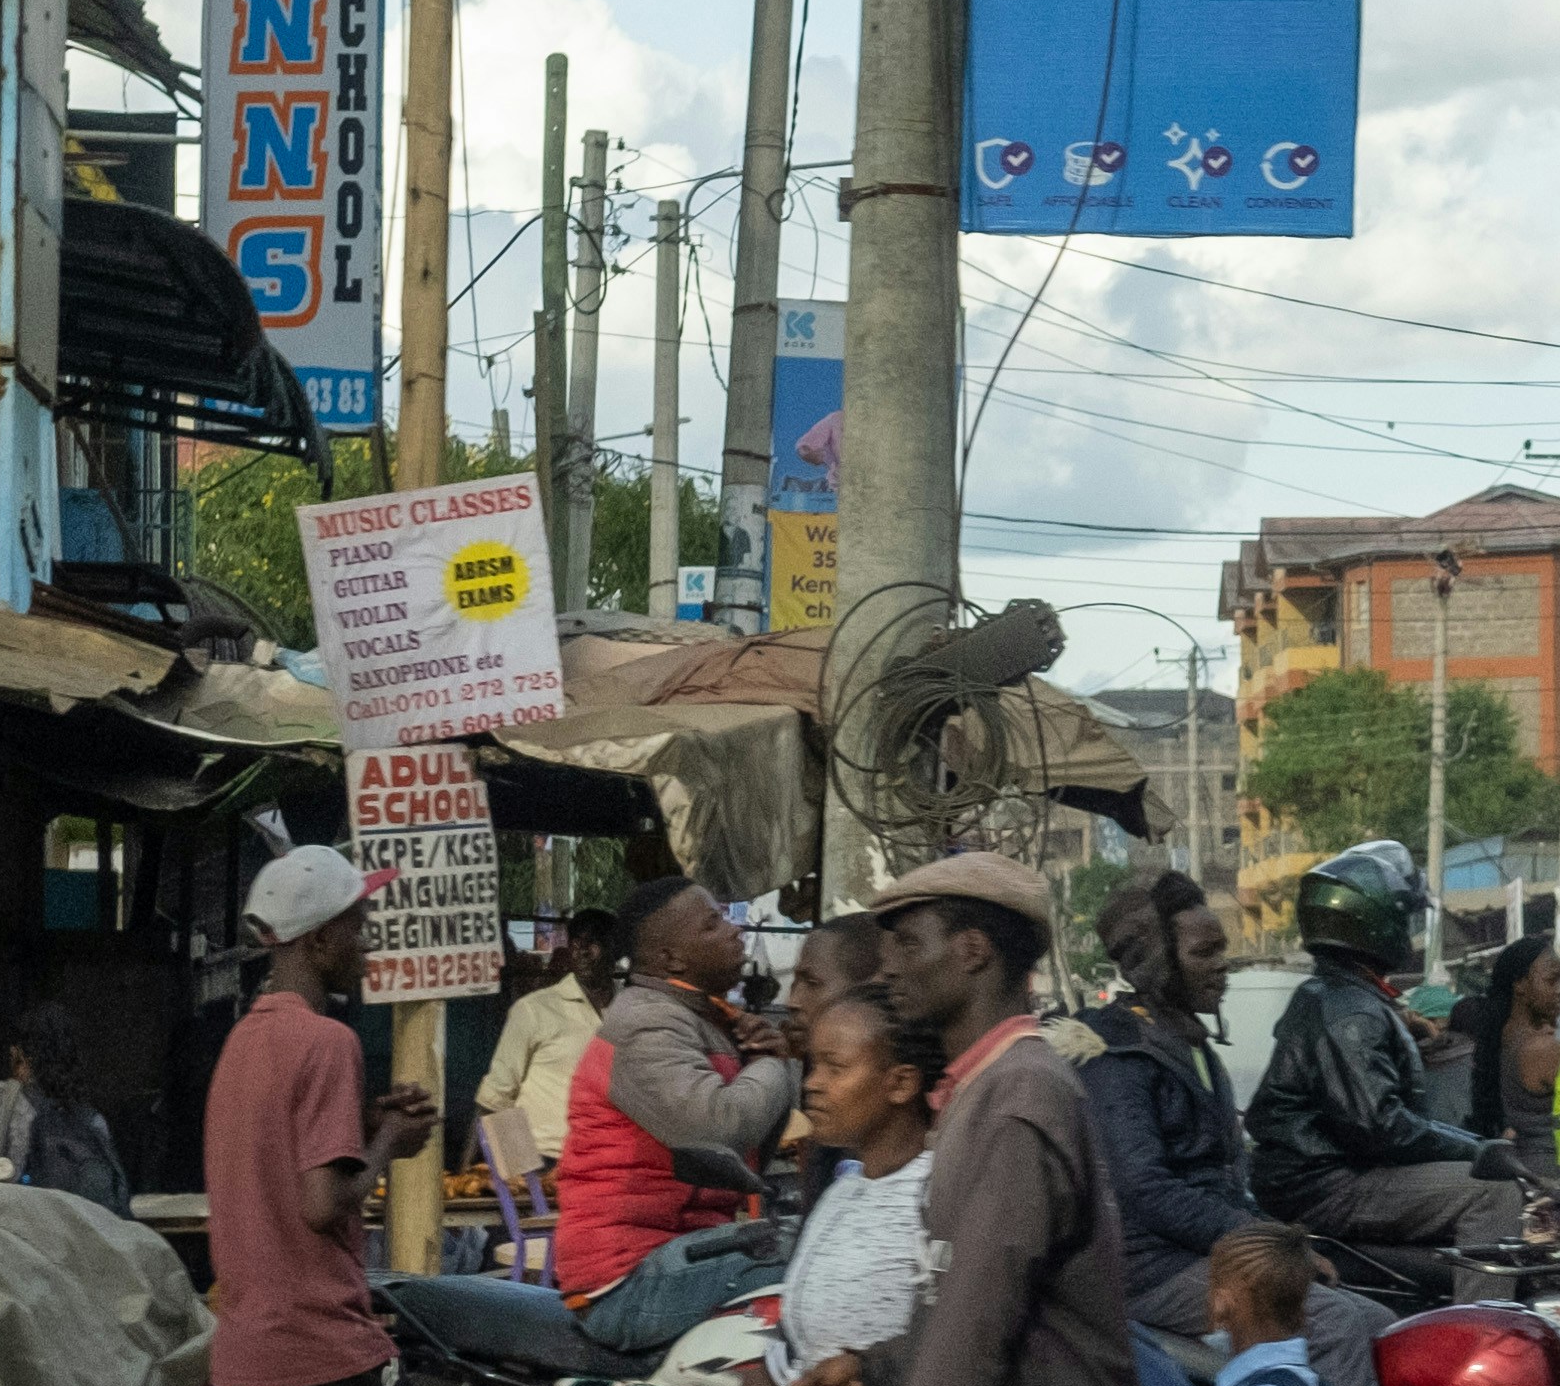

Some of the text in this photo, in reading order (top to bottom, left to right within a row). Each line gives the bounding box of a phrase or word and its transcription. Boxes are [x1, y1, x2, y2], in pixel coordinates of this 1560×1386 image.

[1167, 195, 1224, 209] CLEAN
[315, 485, 532, 539] MUSIC CLASSES
[329, 541, 393, 567] PIANO
[334, 570, 408, 598] GUITAR
[458, 583, 516, 609] EXAMS
[792, 574, 837, 594] Ken
[338, 601, 408, 629] VIOLIN
[344, 630, 422, 660] VOCALS
[350, 655, 470, 691] SAXOPHONE
[460, 678, 504, 701] 272
[514, 671, 559, 694] 725
[360, 752, 471, 789] ADUL
[357, 788, 490, 825] SCHOOL
[361, 911, 496, 951] BEGINNERS
